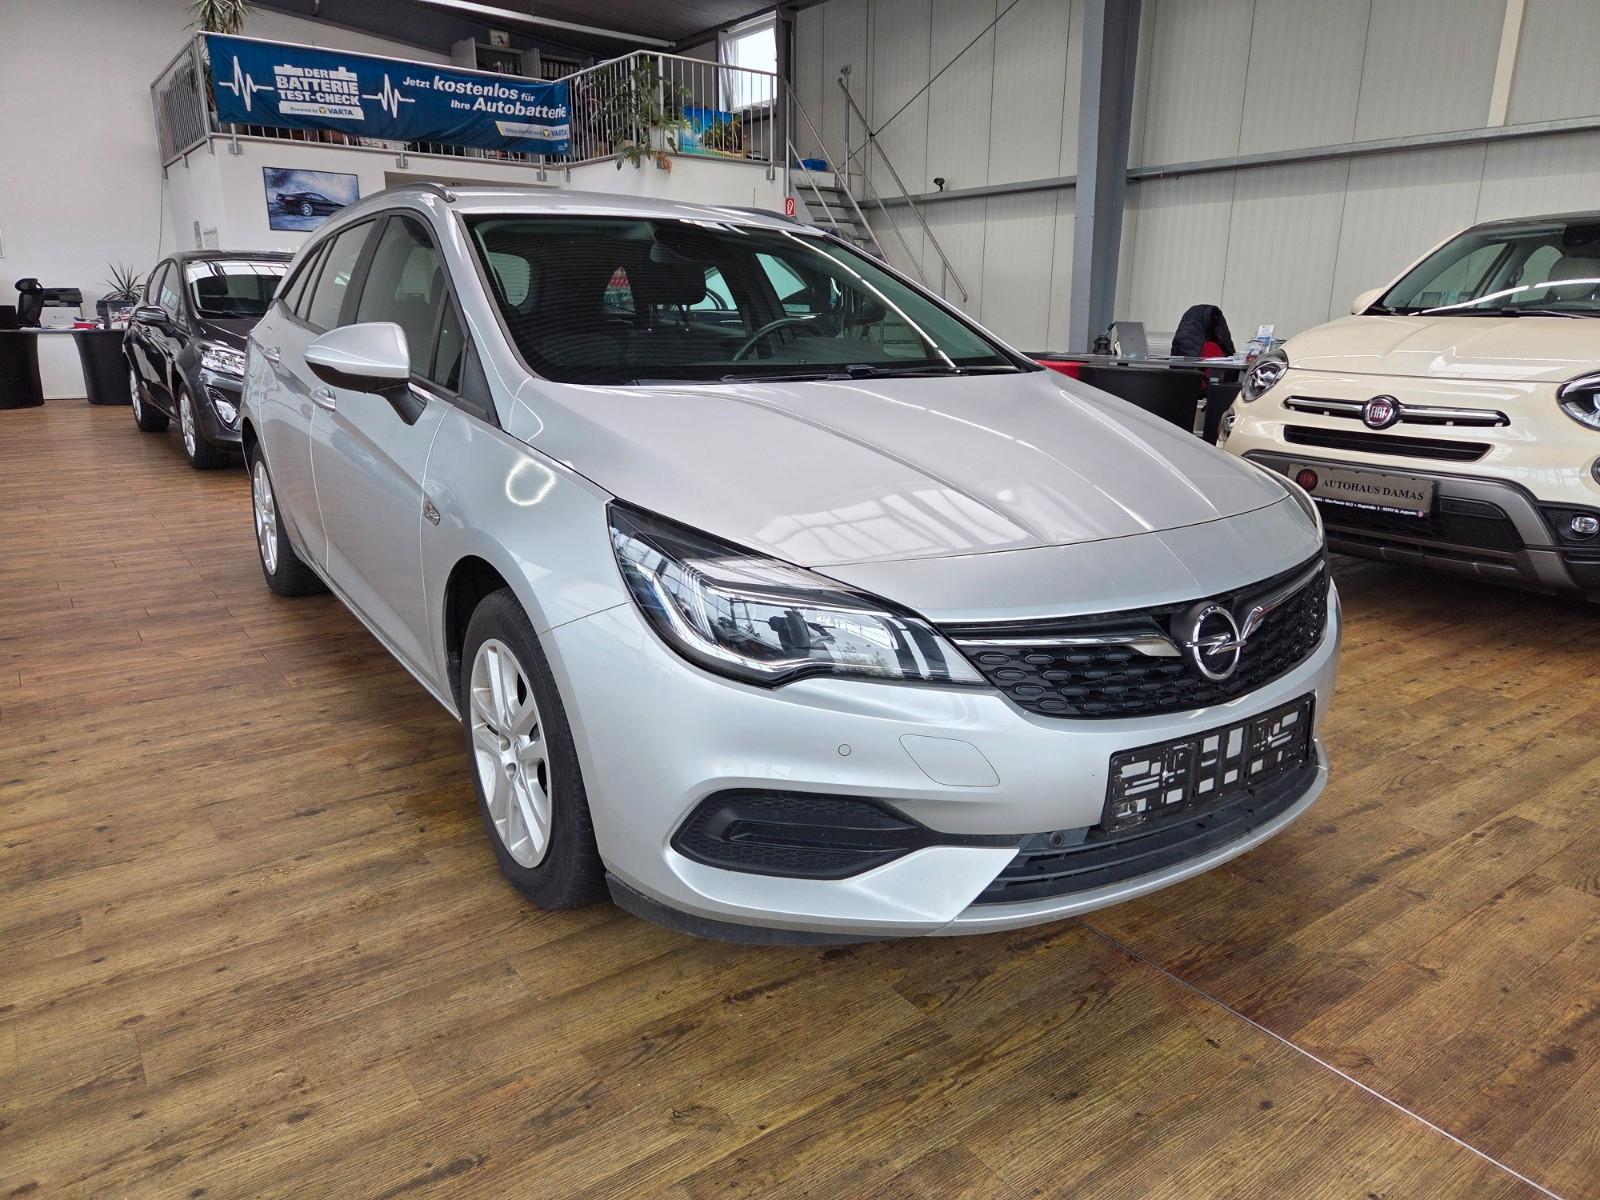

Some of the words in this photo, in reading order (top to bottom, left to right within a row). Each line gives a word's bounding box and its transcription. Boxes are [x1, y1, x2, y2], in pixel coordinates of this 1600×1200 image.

[304, 68, 328, 78] DER
[275, 75, 359, 95] BATTERIE
[402, 77, 430, 89] Jetzt
[433, 75, 519, 100] kostenlos
[521, 93, 535, 102] für
[278, 89, 360, 105] TEST-CHECK
[327, 108, 354, 116] VARTA
[451, 100, 471, 110] Ihre
[472, 97, 566, 119] Autobatterie
[551, 128, 567, 137] VARTA
[1370, 406, 1388, 419] FIAT
[1322, 479, 1381, 495] AUTOHAUS
[1383, 487, 1424, 501] DAMAS
